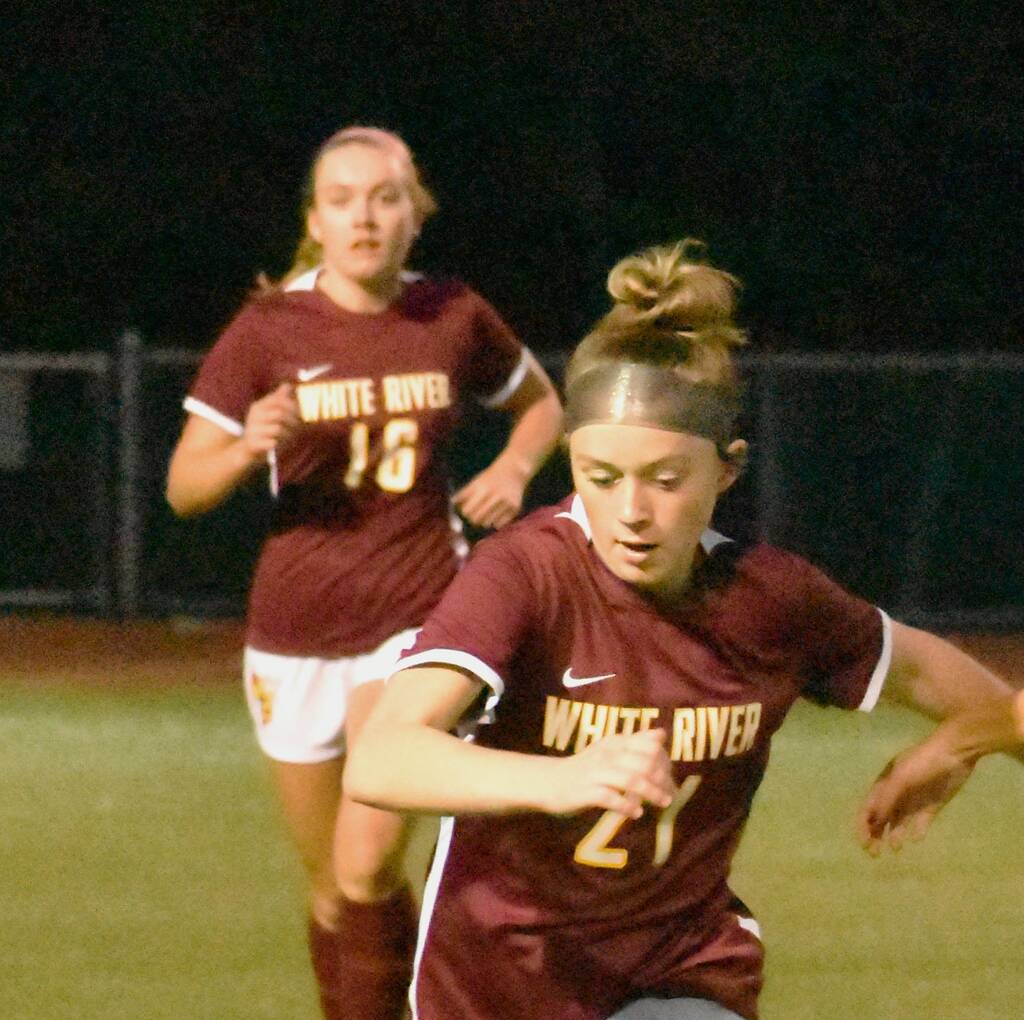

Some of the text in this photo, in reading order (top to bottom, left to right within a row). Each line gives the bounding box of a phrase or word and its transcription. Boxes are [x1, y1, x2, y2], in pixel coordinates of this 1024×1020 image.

[296, 378, 376, 422] WHITE
[344, 419, 419, 493] 16
[670, 702, 762, 762] RIVER
